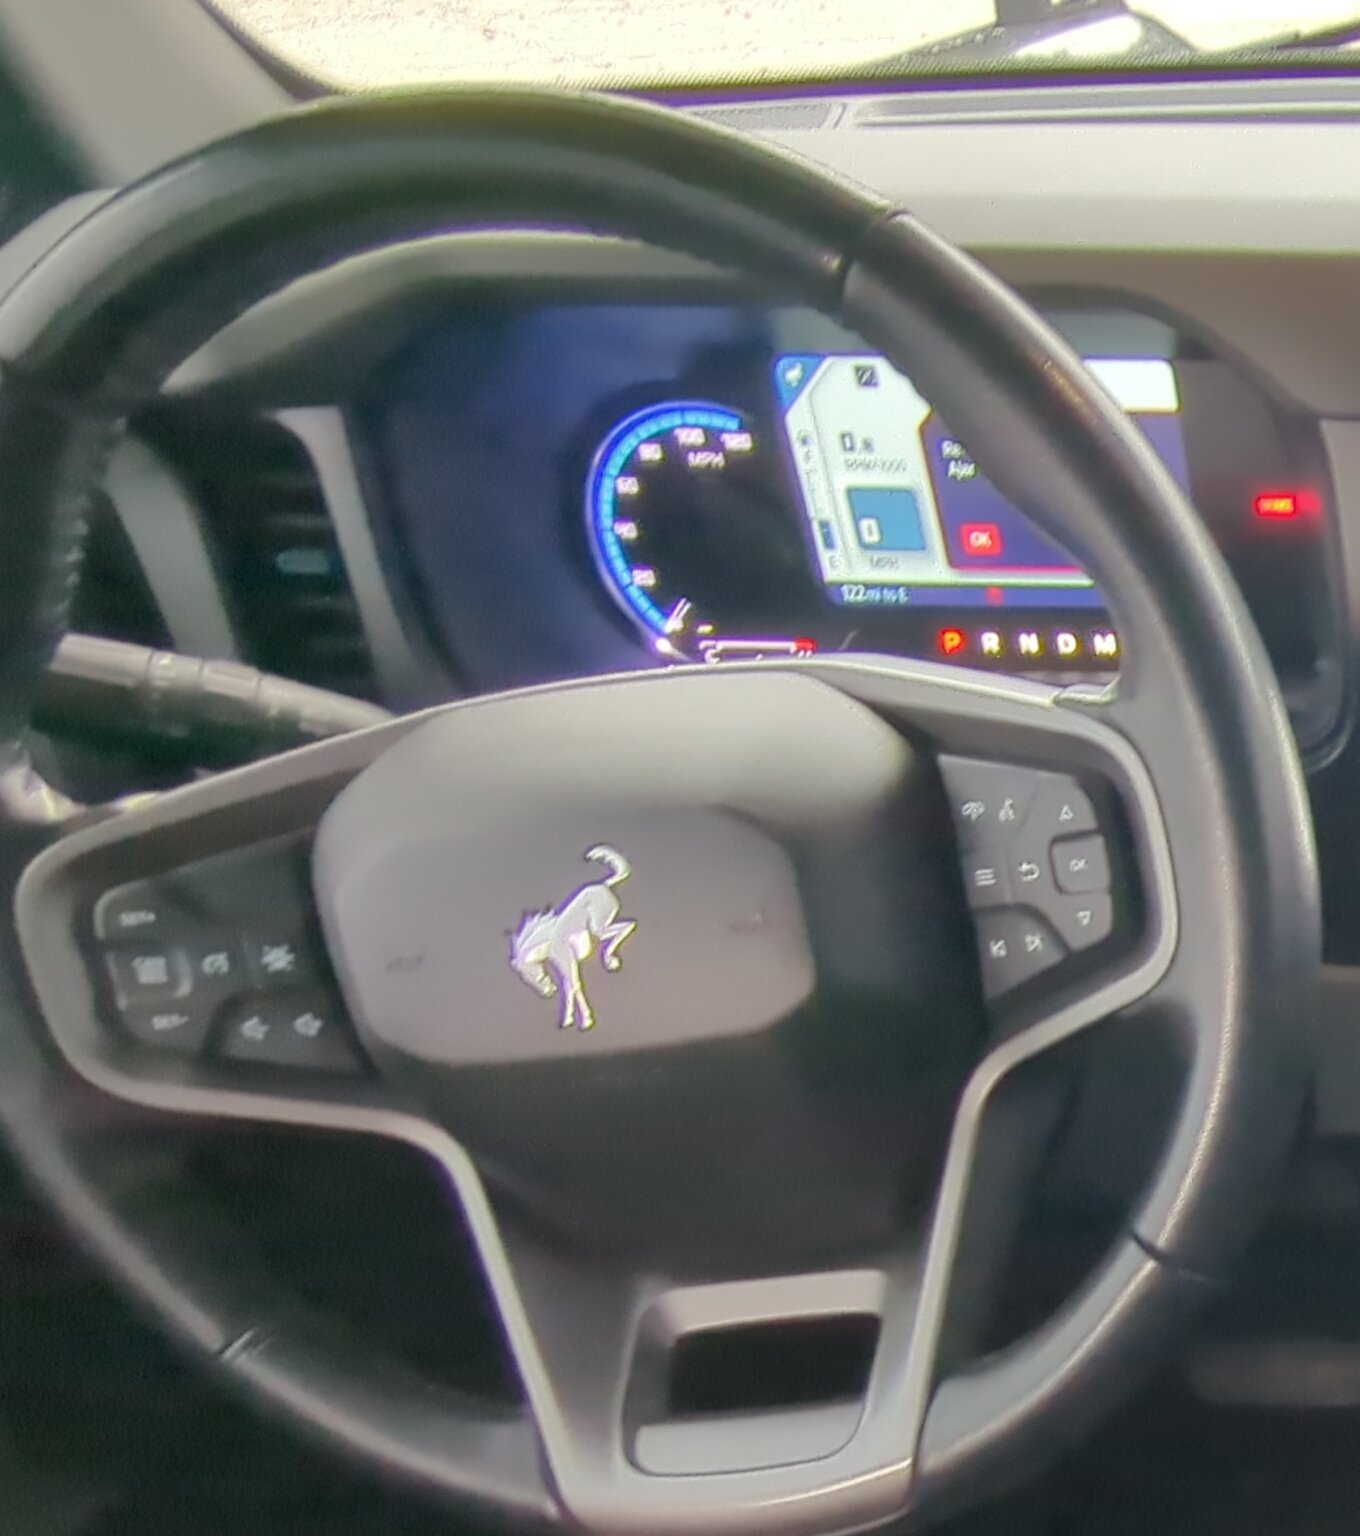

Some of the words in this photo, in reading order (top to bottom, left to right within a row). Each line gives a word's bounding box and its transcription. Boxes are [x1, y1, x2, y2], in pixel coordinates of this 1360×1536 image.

[943, 631, 961, 654] P
[981, 632, 1000, 654] R
[1019, 633, 1040, 654] N
[1057, 633, 1077, 655] D
[1094, 634, 1117, 655] M
